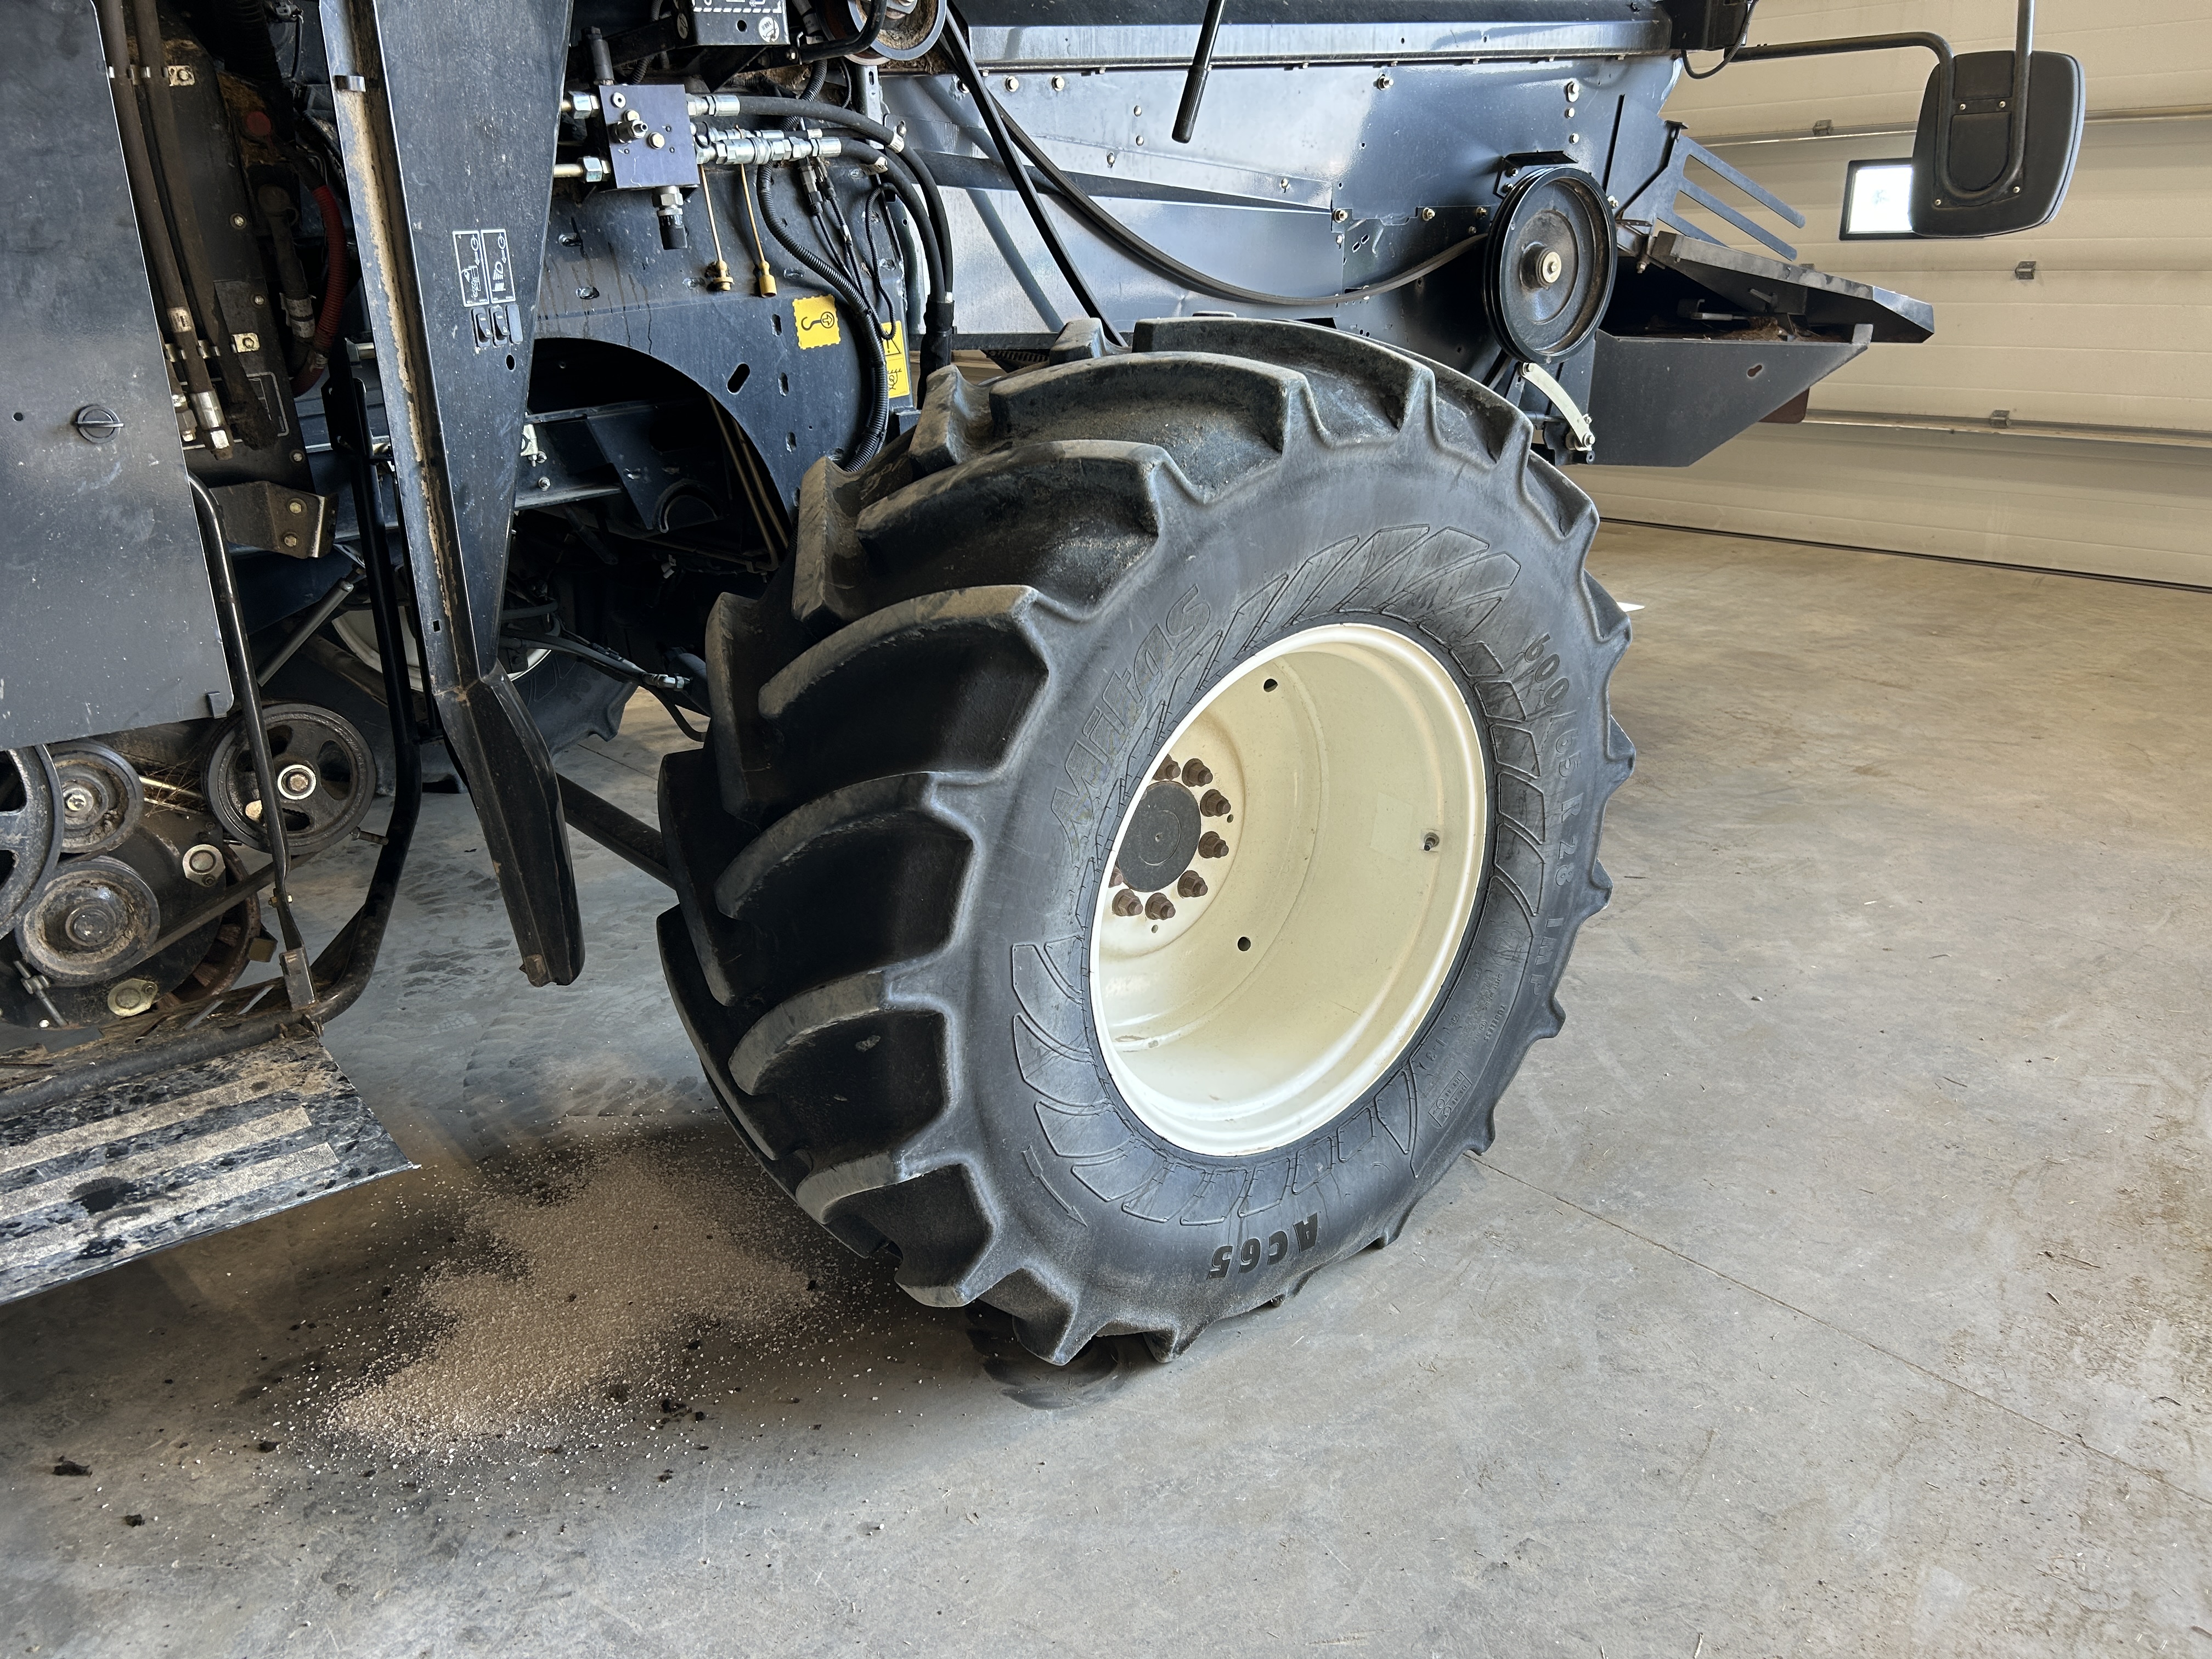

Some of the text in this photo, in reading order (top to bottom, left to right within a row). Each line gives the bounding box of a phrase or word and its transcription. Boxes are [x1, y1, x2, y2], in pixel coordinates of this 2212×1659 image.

[1529, 917, 1564, 996] IMP
[1483, 1005, 1506, 1042] TUBELESS
[1207, 1212, 1318, 1280] AC65
